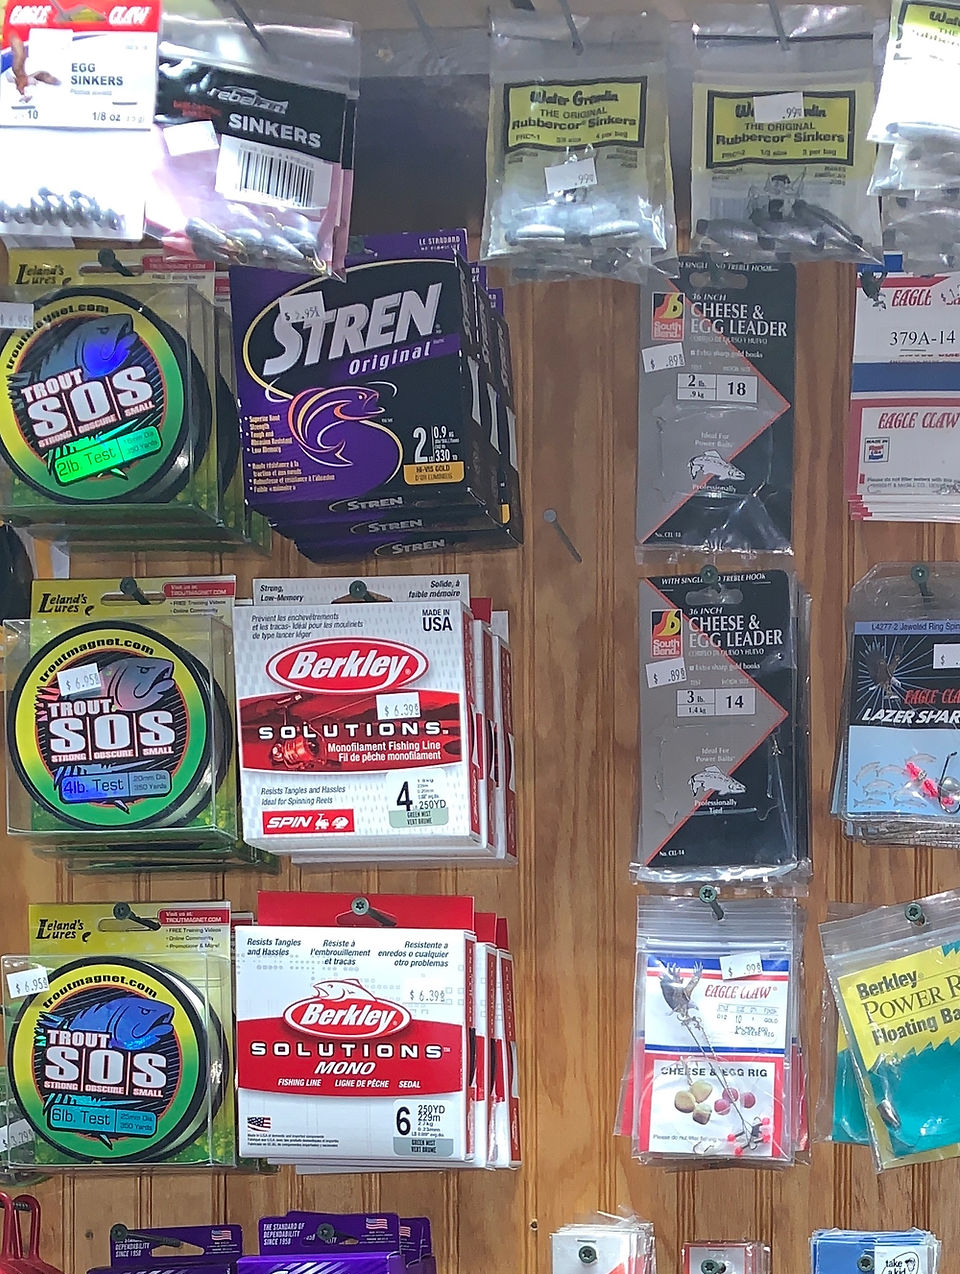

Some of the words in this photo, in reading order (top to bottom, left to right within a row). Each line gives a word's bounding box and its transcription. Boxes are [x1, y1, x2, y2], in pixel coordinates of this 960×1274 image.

[109, 5, 150, 24] CLAW
[71, 63, 96, 73] EGG
[70, 74, 124, 87] SINKERS
[228, 113, 322, 149] SINKERS
[793, 132, 845, 144] Sinkers
[690, 302, 748, 321] CHEESE
[752, 305, 765, 320] &
[263, 283, 442, 376] STREN
[653, 321, 683, 332] South
[690, 319, 726, 336] EGG
[730, 320, 788, 337] LEADER
[889, 329, 957, 347] 379A-14
[348, 341, 431, 376] Original
[727, 381, 747, 396] 18
[878, 412, 916, 429] EAGLE
[921, 412, 960, 429] CLAW
[413, 426, 428, 463] 2
[421, 609, 441, 618] MADE
[443, 609, 450, 617] IN
[422, 616, 453, 633] USA
[929, 623, 945, 631] Ring
[653, 647, 676, 656] Bend
[288, 649, 408, 683] Berkley
[726, 695, 744, 709] 14
[904, 689, 937, 704] EAGLE
[48, 699, 113, 717] TROUT
[862, 708, 913, 723] LAZER
[258, 721, 443, 740] SOLUTIONS
[50, 752, 87, 762] STRONG
[93, 749, 134, 759] OBSCURE
[142, 746, 174, 755] SMALL
[327, 742, 388, 754] Monofilament
[389, 742, 420, 754] Fishing
[422, 741, 441, 752] Line
[339, 753, 348, 762] Fil
[350, 753, 360, 762] de
[362, 752, 387, 764] pêche
[388, 751, 441, 762] monofilament
[93, 777, 124, 793] Test
[261, 786, 283, 796] Resists
[285, 785, 308, 797] Tangles
[309, 785, 321, 794] and
[322, 784, 346, 794] Hassles
[396, 782, 413, 811] 4
[419, 800, 446, 811] 250YD
[266, 815, 313, 830] SPIN
[43, 973, 158, 1010] troutmagnet.com
[856, 970, 918, 1001] Berkley
[863, 986, 944, 1024] POWER
[302, 1004, 398, 1029] Berkley
[872, 1015, 937, 1045] Floating
[250, 1042, 443, 1059] SOLUTIONS
[314, 1061, 376, 1075] MONO
[660, 1067, 706, 1076] CHEESE
[722, 1068, 745, 1078] EGG
[748, 1068, 768, 1078] RIG
[278, 1078, 305, 1087] FISHING
[307, 1078, 321, 1087] LINE
[335, 1079, 355, 1088] LIGNE
[356, 1079, 364, 1088] DE
[399, 1079, 421, 1088] SEDAL
[78, 1112, 110, 1126] Test
[396, 1106, 411, 1135] 6
